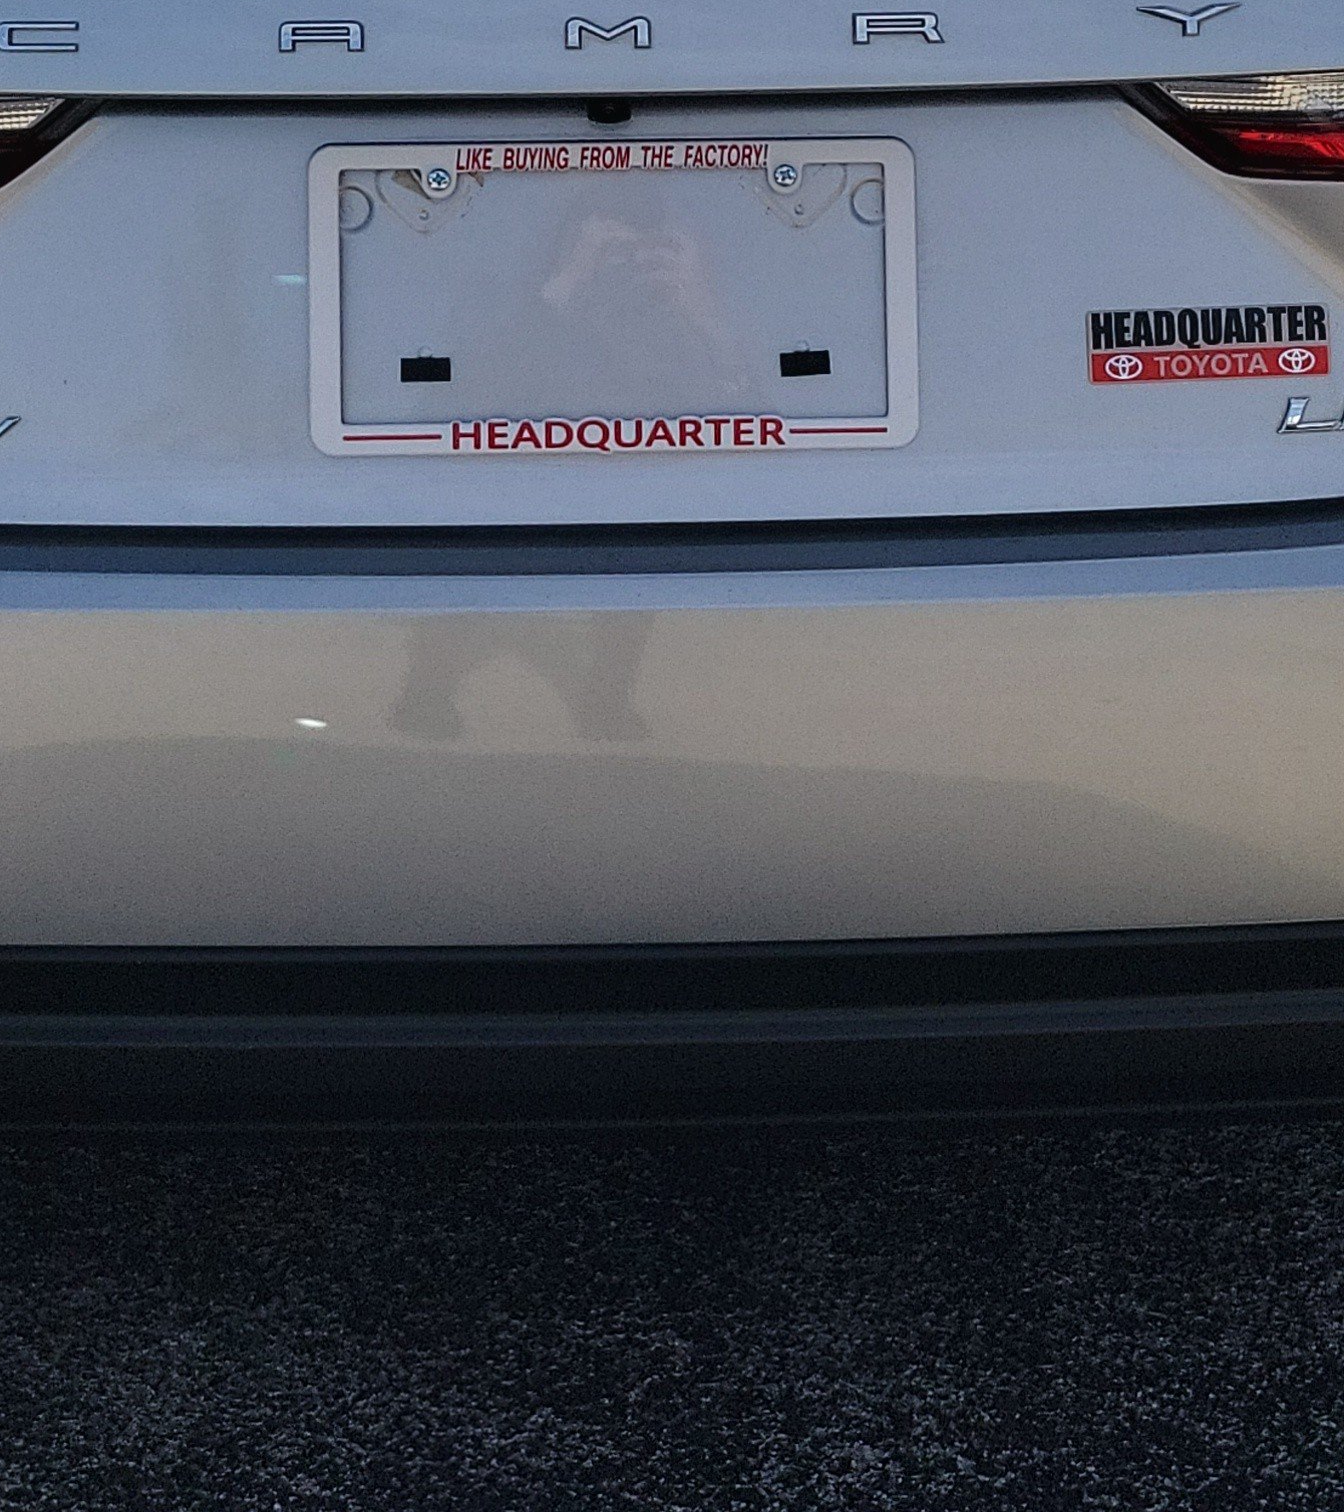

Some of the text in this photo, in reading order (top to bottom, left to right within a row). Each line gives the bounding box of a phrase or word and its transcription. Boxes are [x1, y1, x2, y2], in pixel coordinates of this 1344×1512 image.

[456, 144, 769, 171] LIKE BUYING FROM THE FACTORY!
[1090, 304, 1327, 351] HEADQUARTER
[1153, 351, 1269, 379] TOYOTA
[451, 416, 787, 453] HEADQUARTER
